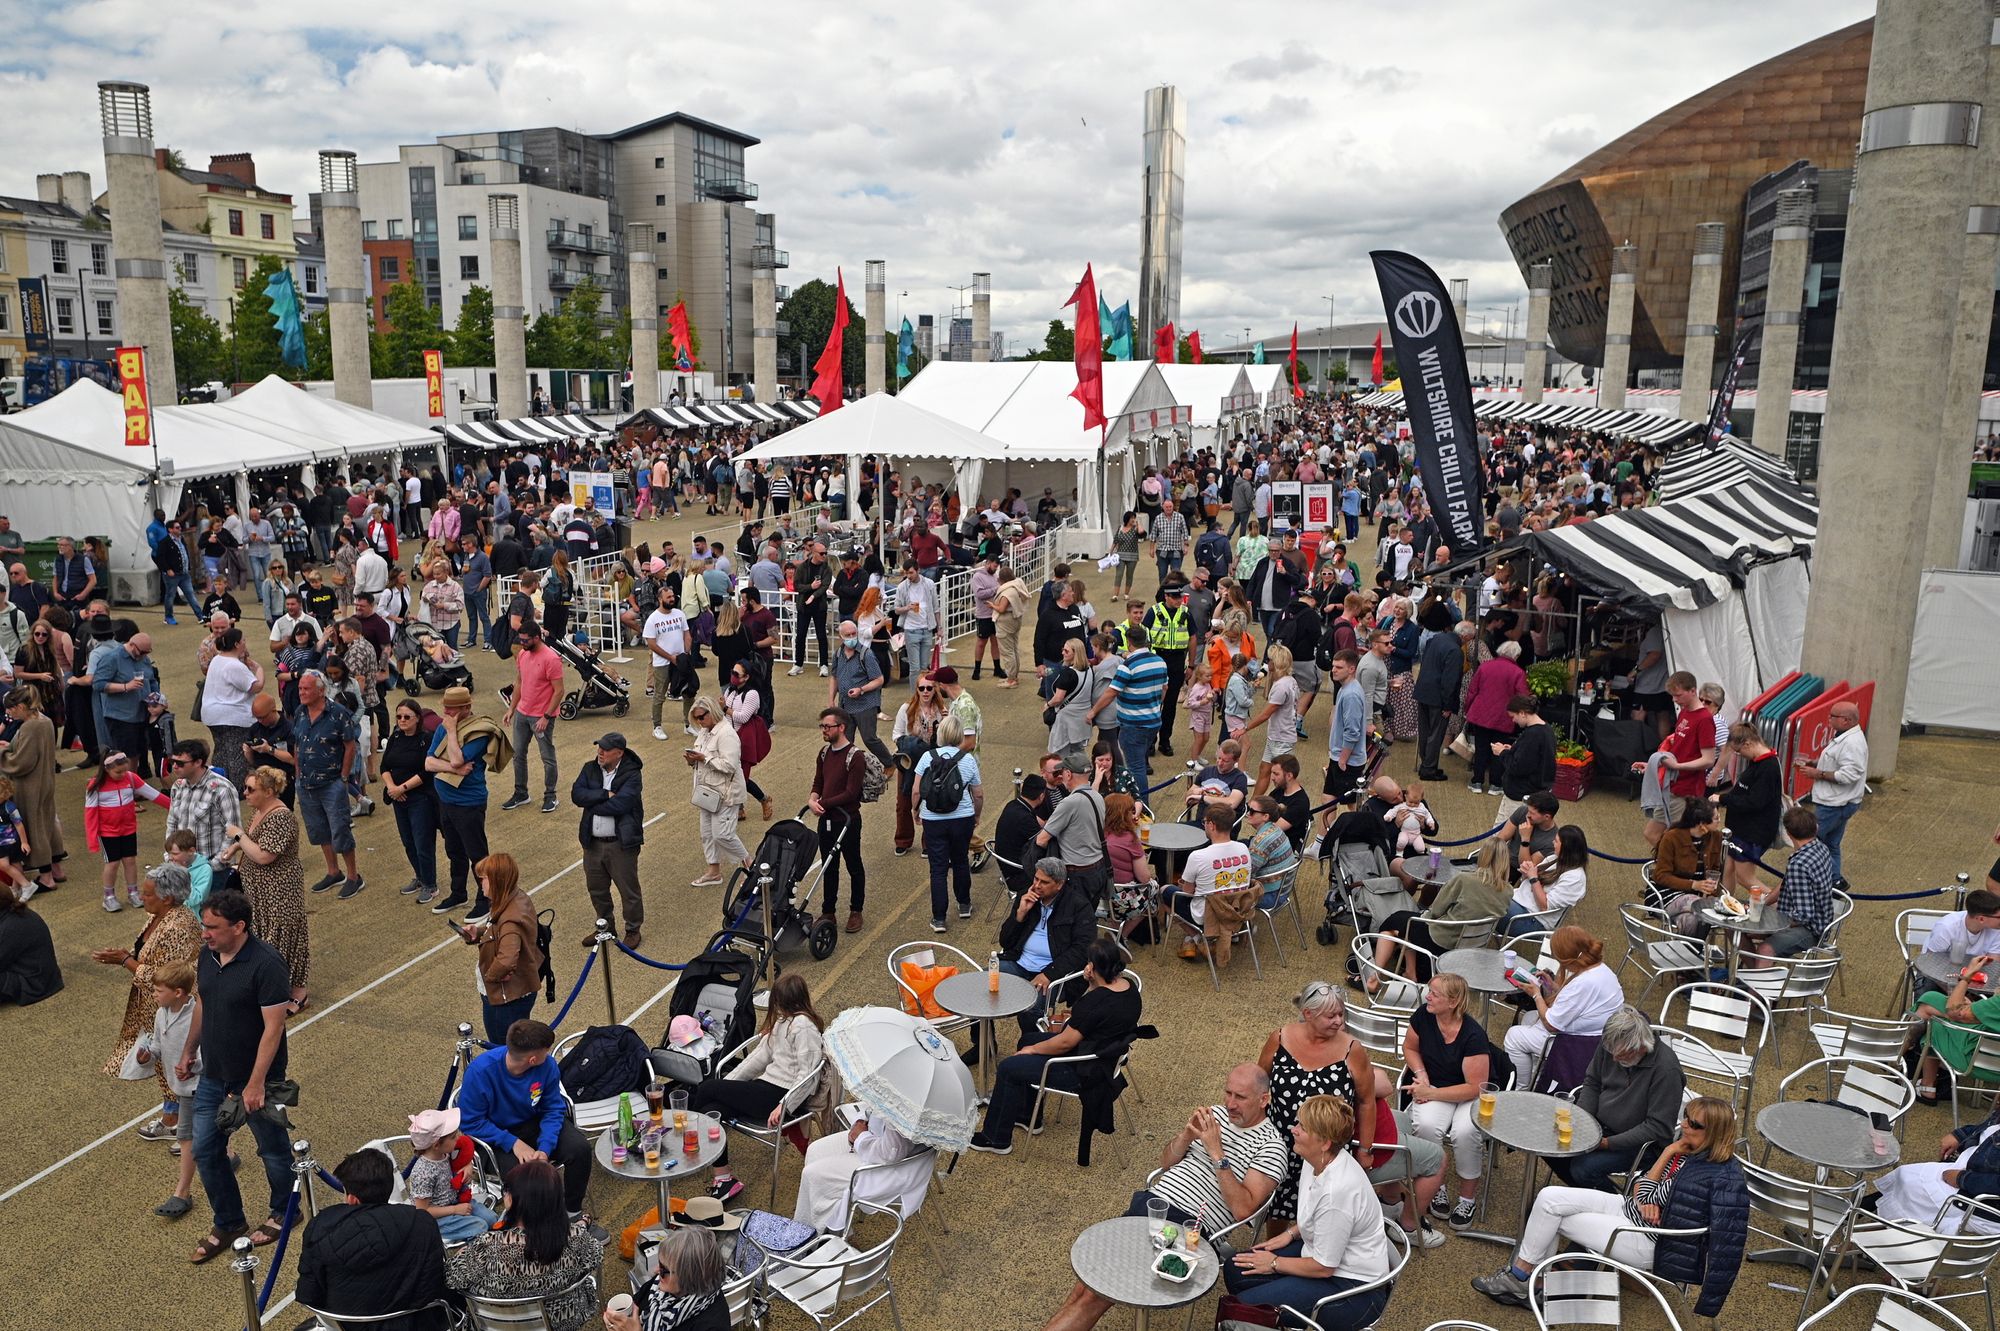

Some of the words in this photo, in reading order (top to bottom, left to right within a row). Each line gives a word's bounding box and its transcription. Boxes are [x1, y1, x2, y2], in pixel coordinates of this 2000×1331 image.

[1417, 346, 1455, 442] WILTSHIRE
[1438, 443, 1463, 501] CHILLI
[1449, 500, 1477, 547] FARM
[1063, 619, 1081, 629] PUMA
